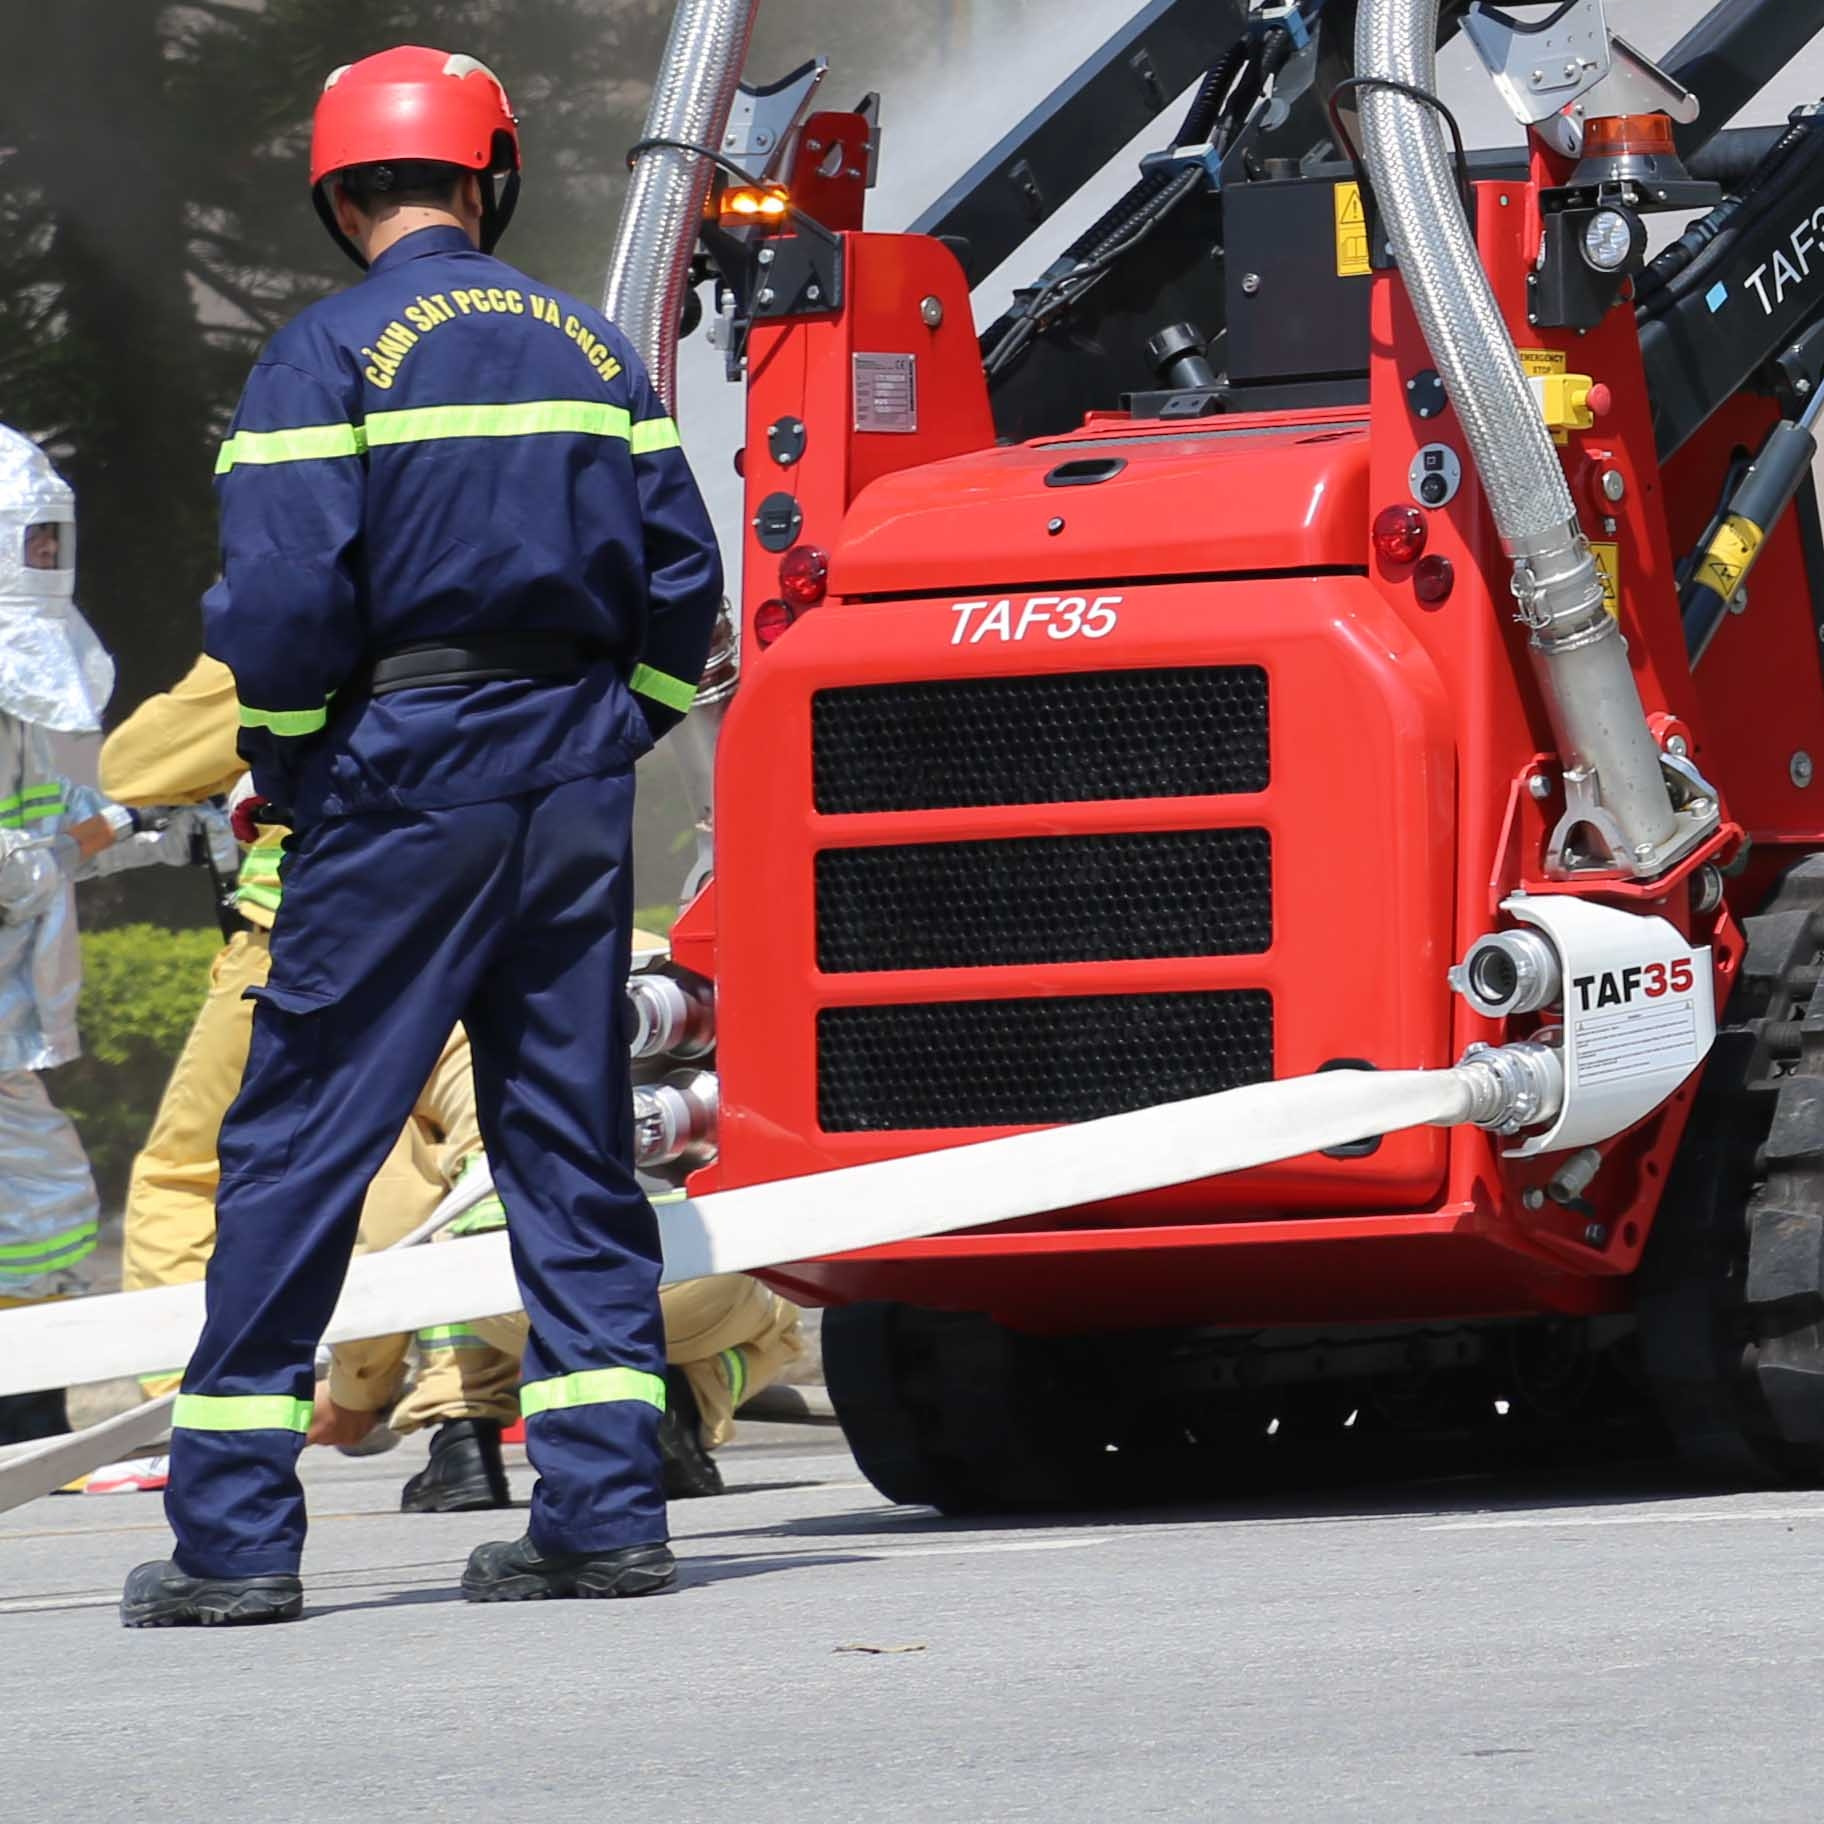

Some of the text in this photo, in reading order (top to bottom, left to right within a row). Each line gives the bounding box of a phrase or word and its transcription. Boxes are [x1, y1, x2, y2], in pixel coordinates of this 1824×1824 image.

[361, 288, 623, 390] CẢNH SÁT PCCC VÀ CNCH
[951, 596, 1123, 645] TAF35
[1573, 957, 1695, 1011] TAF35
